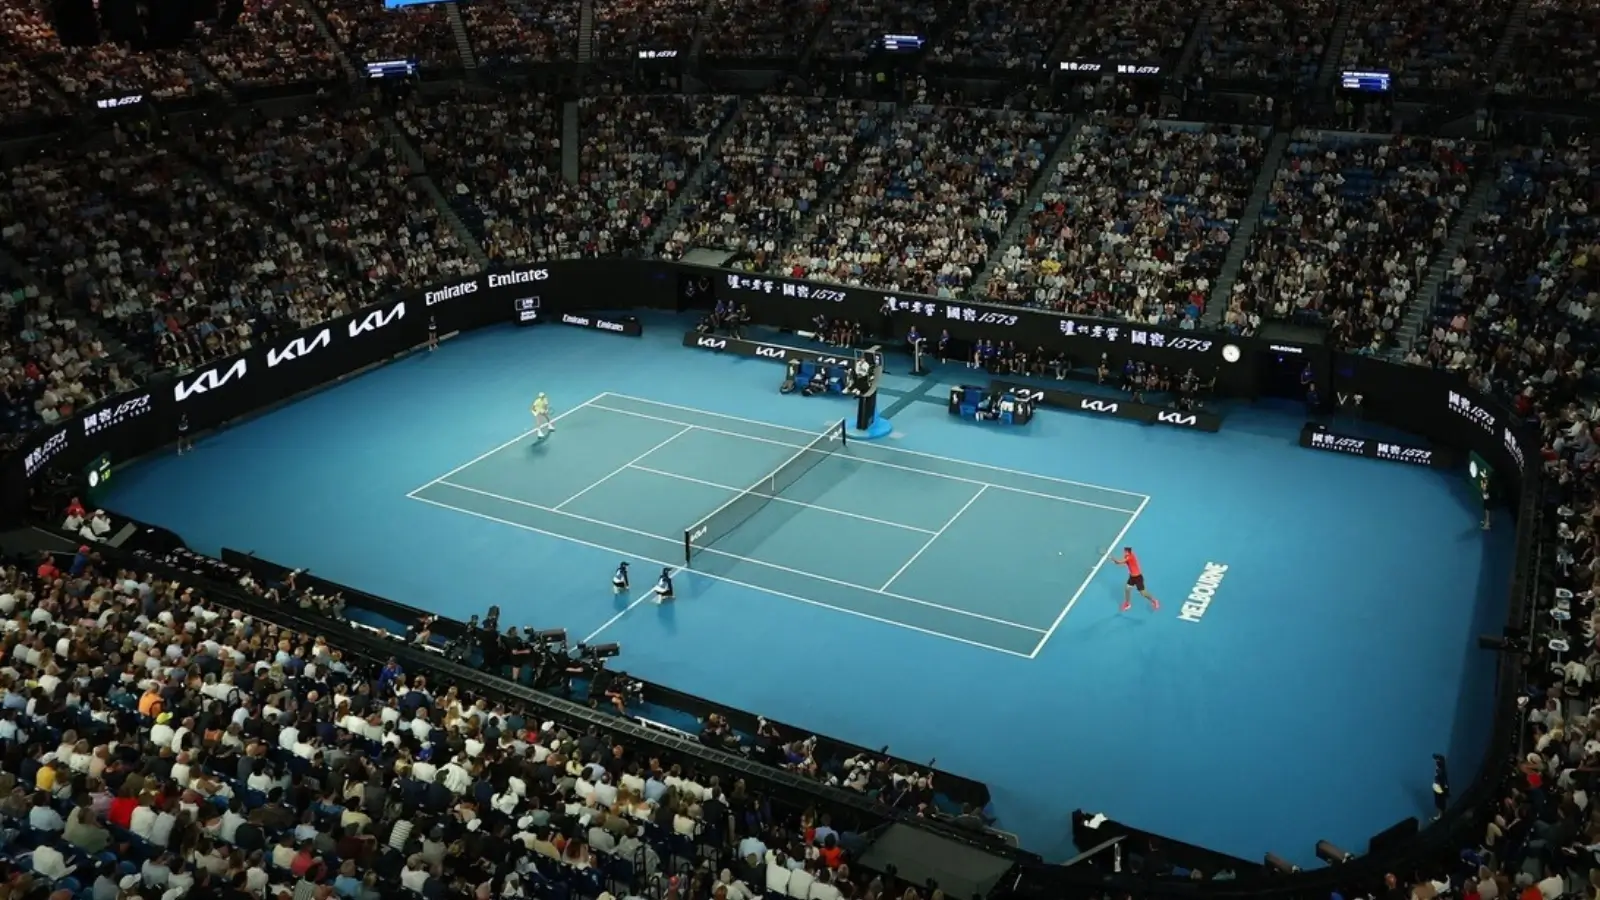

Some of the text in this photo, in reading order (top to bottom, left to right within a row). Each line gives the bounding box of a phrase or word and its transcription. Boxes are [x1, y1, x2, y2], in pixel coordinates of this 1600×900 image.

[488, 268, 549, 288] Emirates
[425, 280, 478, 306] Emirates
[1175, 561, 1229, 623] MELBOURNE
